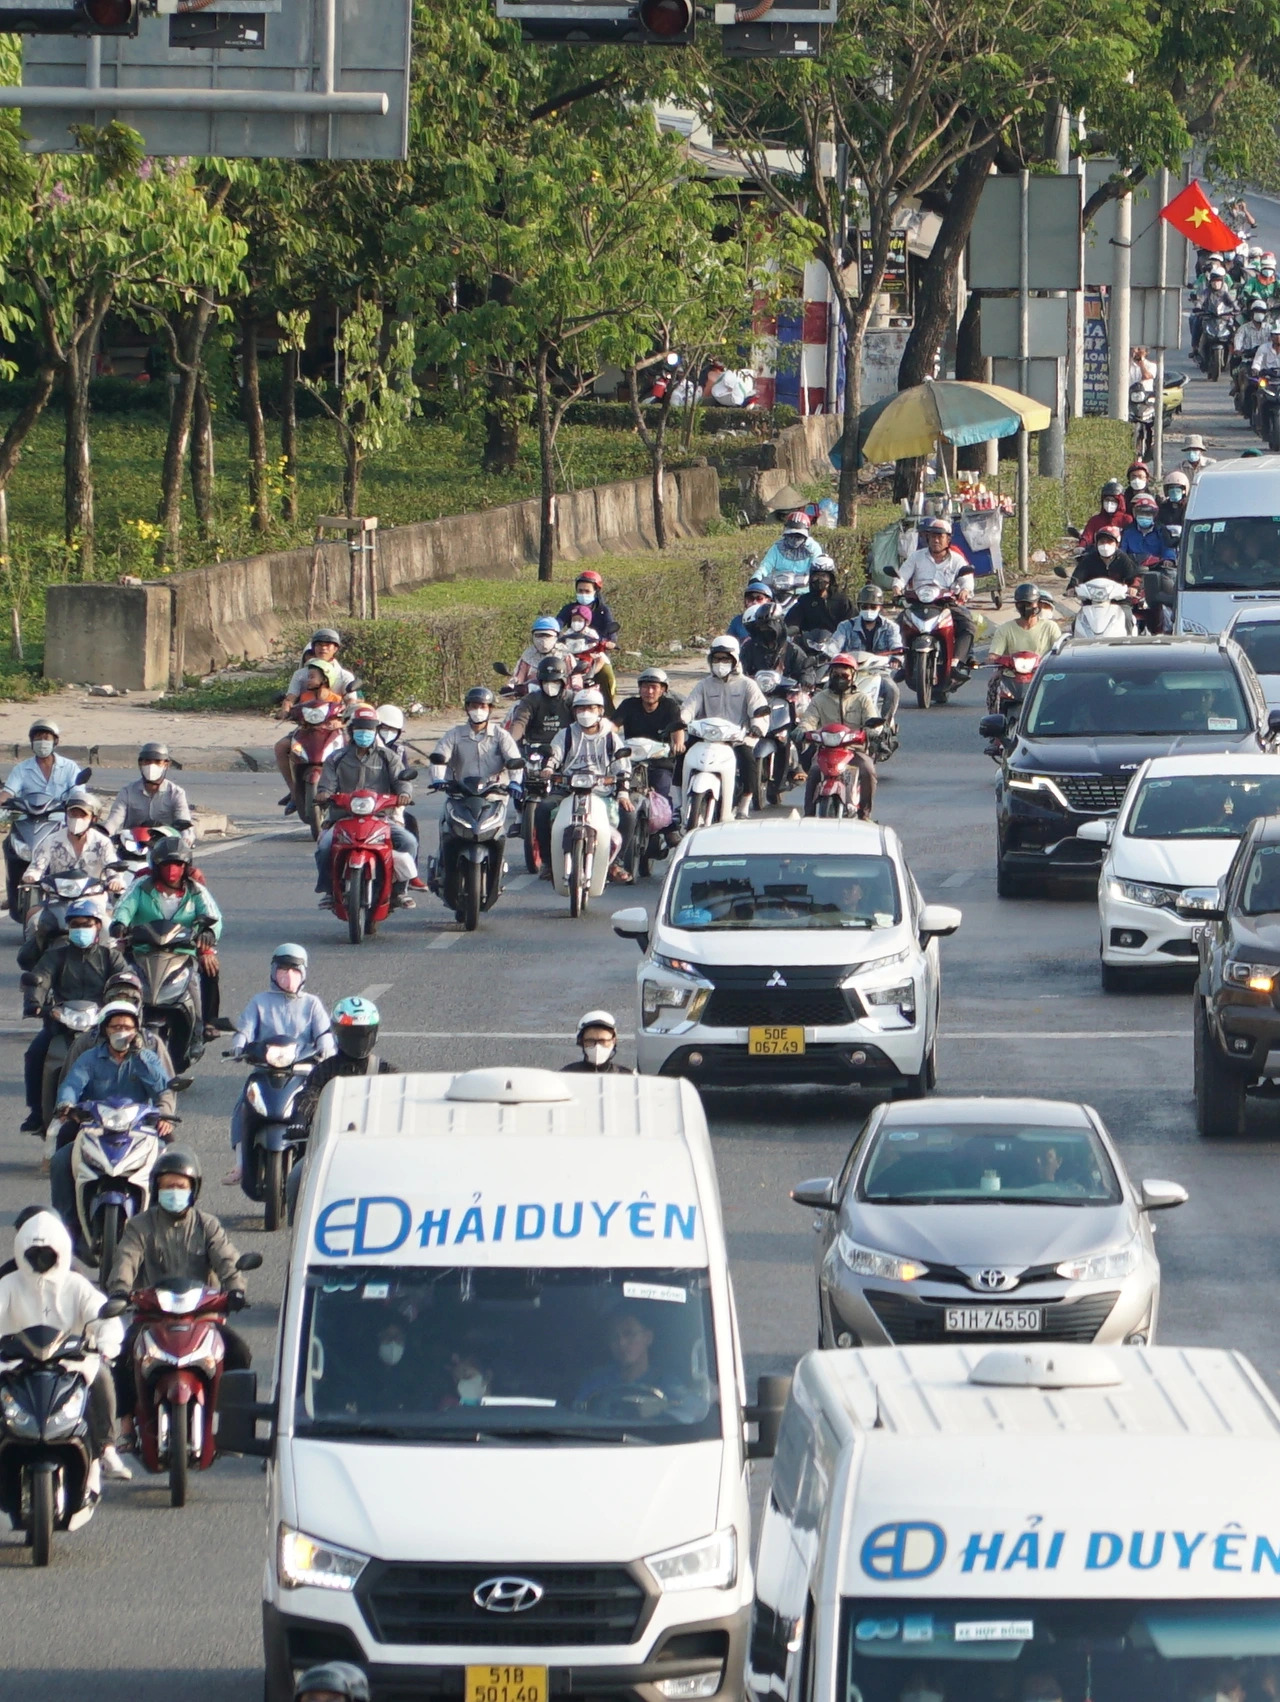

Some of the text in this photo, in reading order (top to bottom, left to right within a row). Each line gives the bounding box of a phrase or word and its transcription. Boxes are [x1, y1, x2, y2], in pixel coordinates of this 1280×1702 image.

[764, 1028, 788, 1040] 50E
[755, 1041, 798, 1054] 067.49
[960, 1514, 1066, 1574] HẢI
[489, 1666, 524, 1685] 51B
[475, 1685, 538, 1702] 501.40
